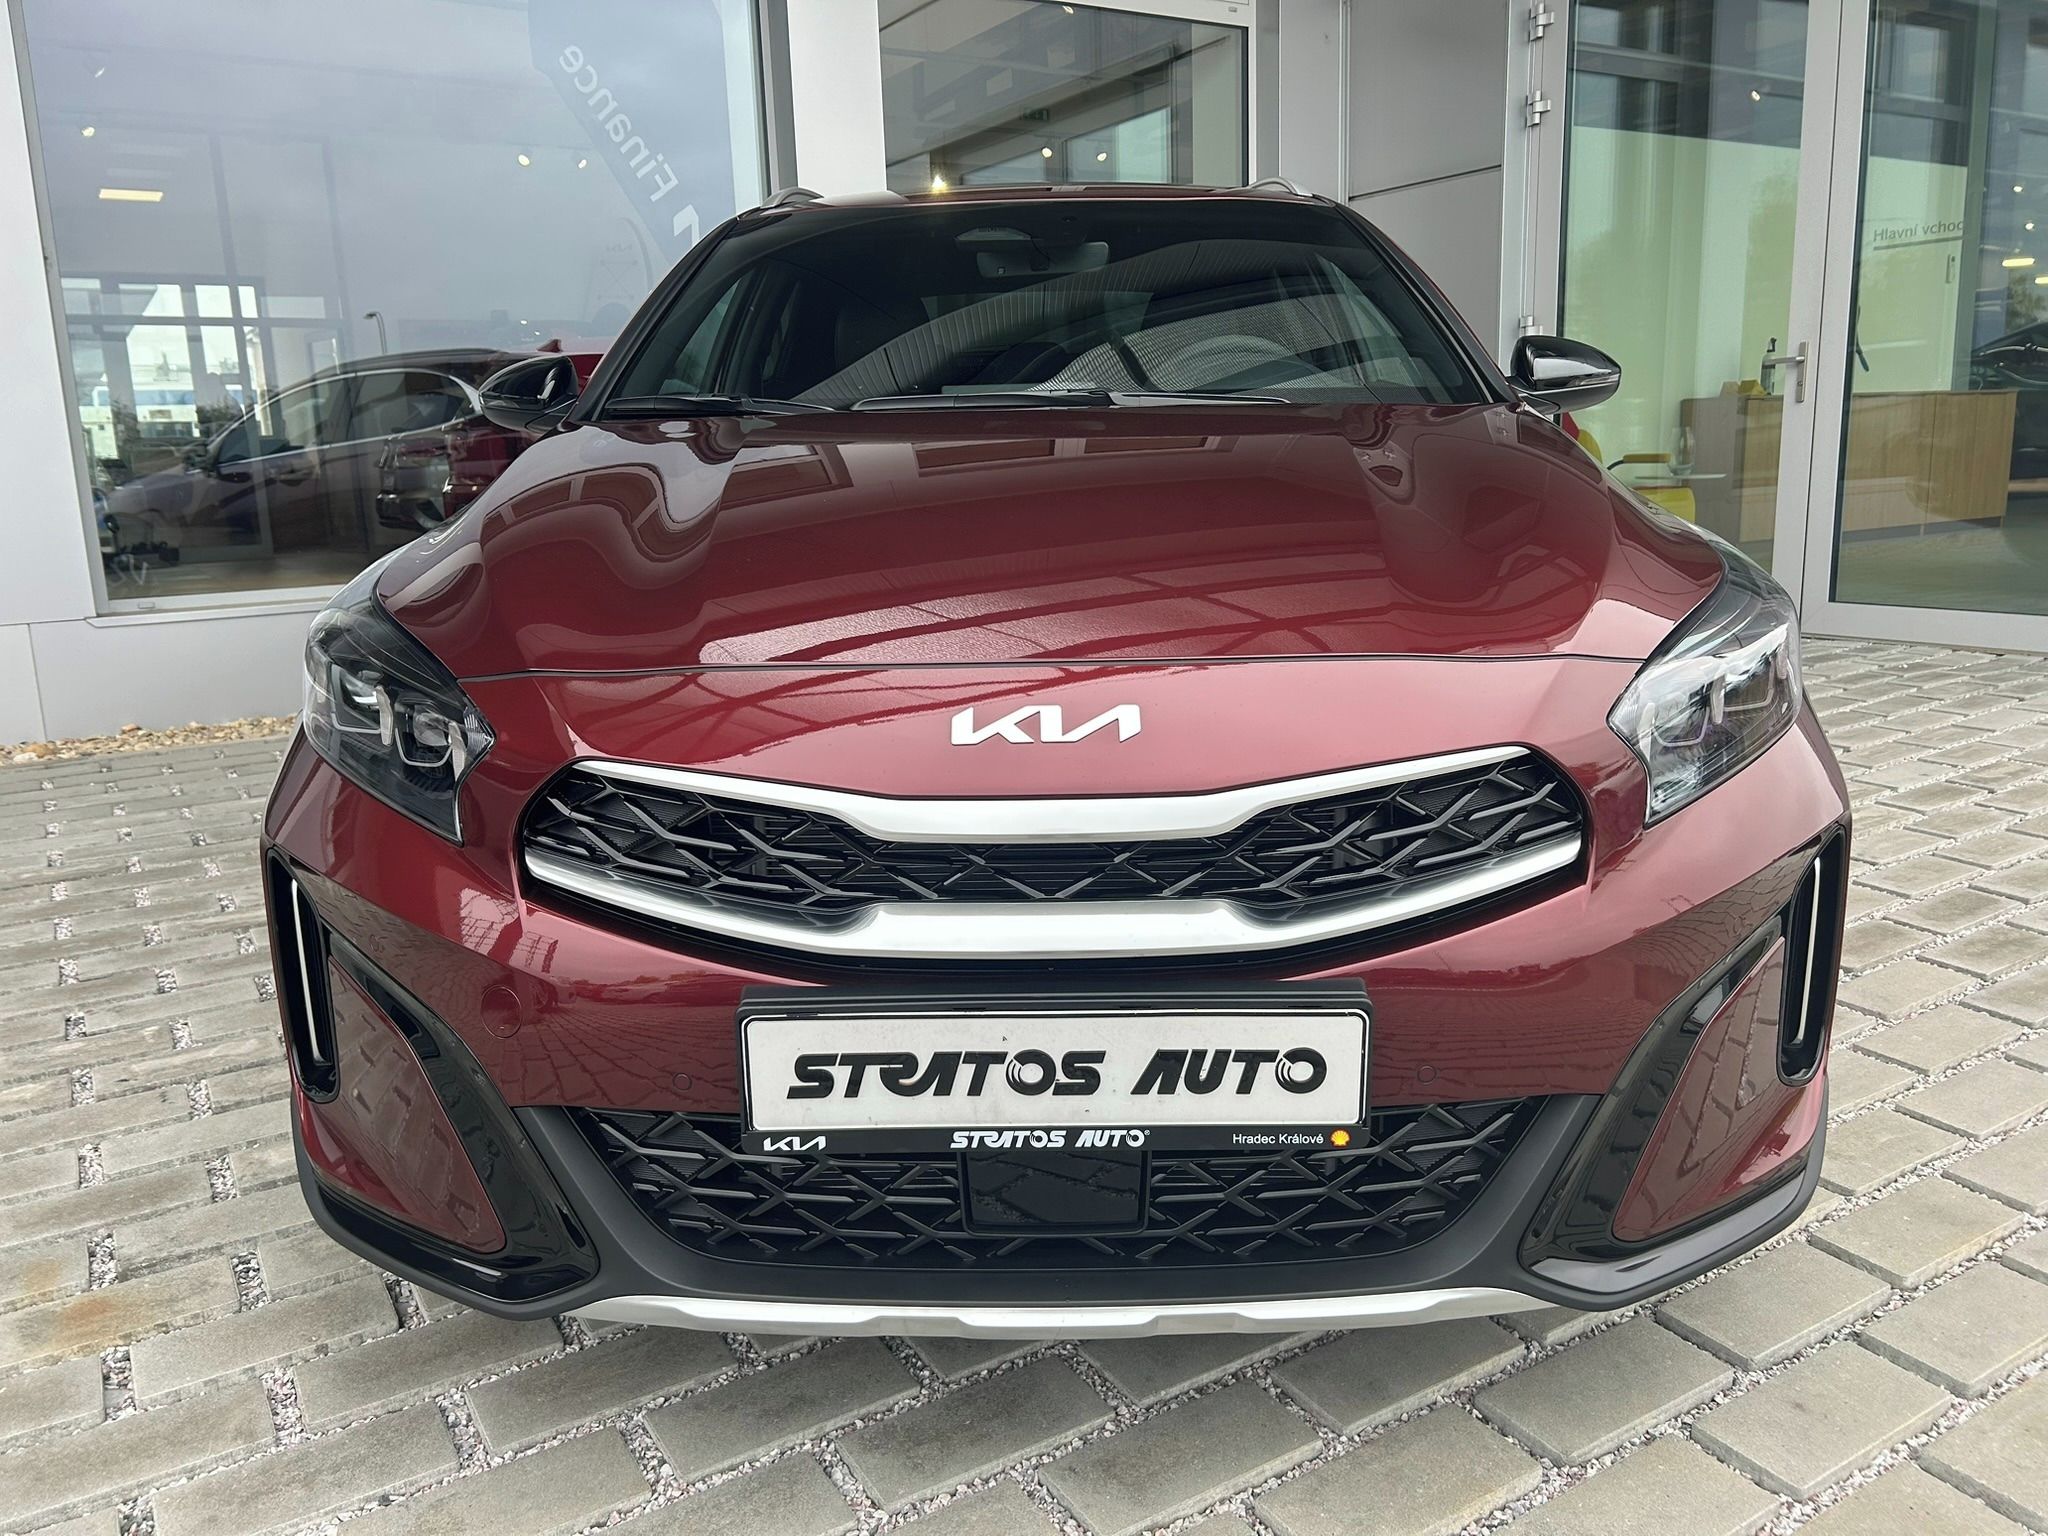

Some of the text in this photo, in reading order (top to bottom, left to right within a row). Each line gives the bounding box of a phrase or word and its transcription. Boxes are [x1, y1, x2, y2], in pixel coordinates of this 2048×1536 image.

[1873, 224, 1919, 242] Hlavní
[951, 704, 1142, 746] KIA
[786, 1047, 1328, 1099] STRATOS AUTO
[950, 1130, 1067, 1149] STRATOS
[1232, 1133, 1324, 1144] Hradec Králové
